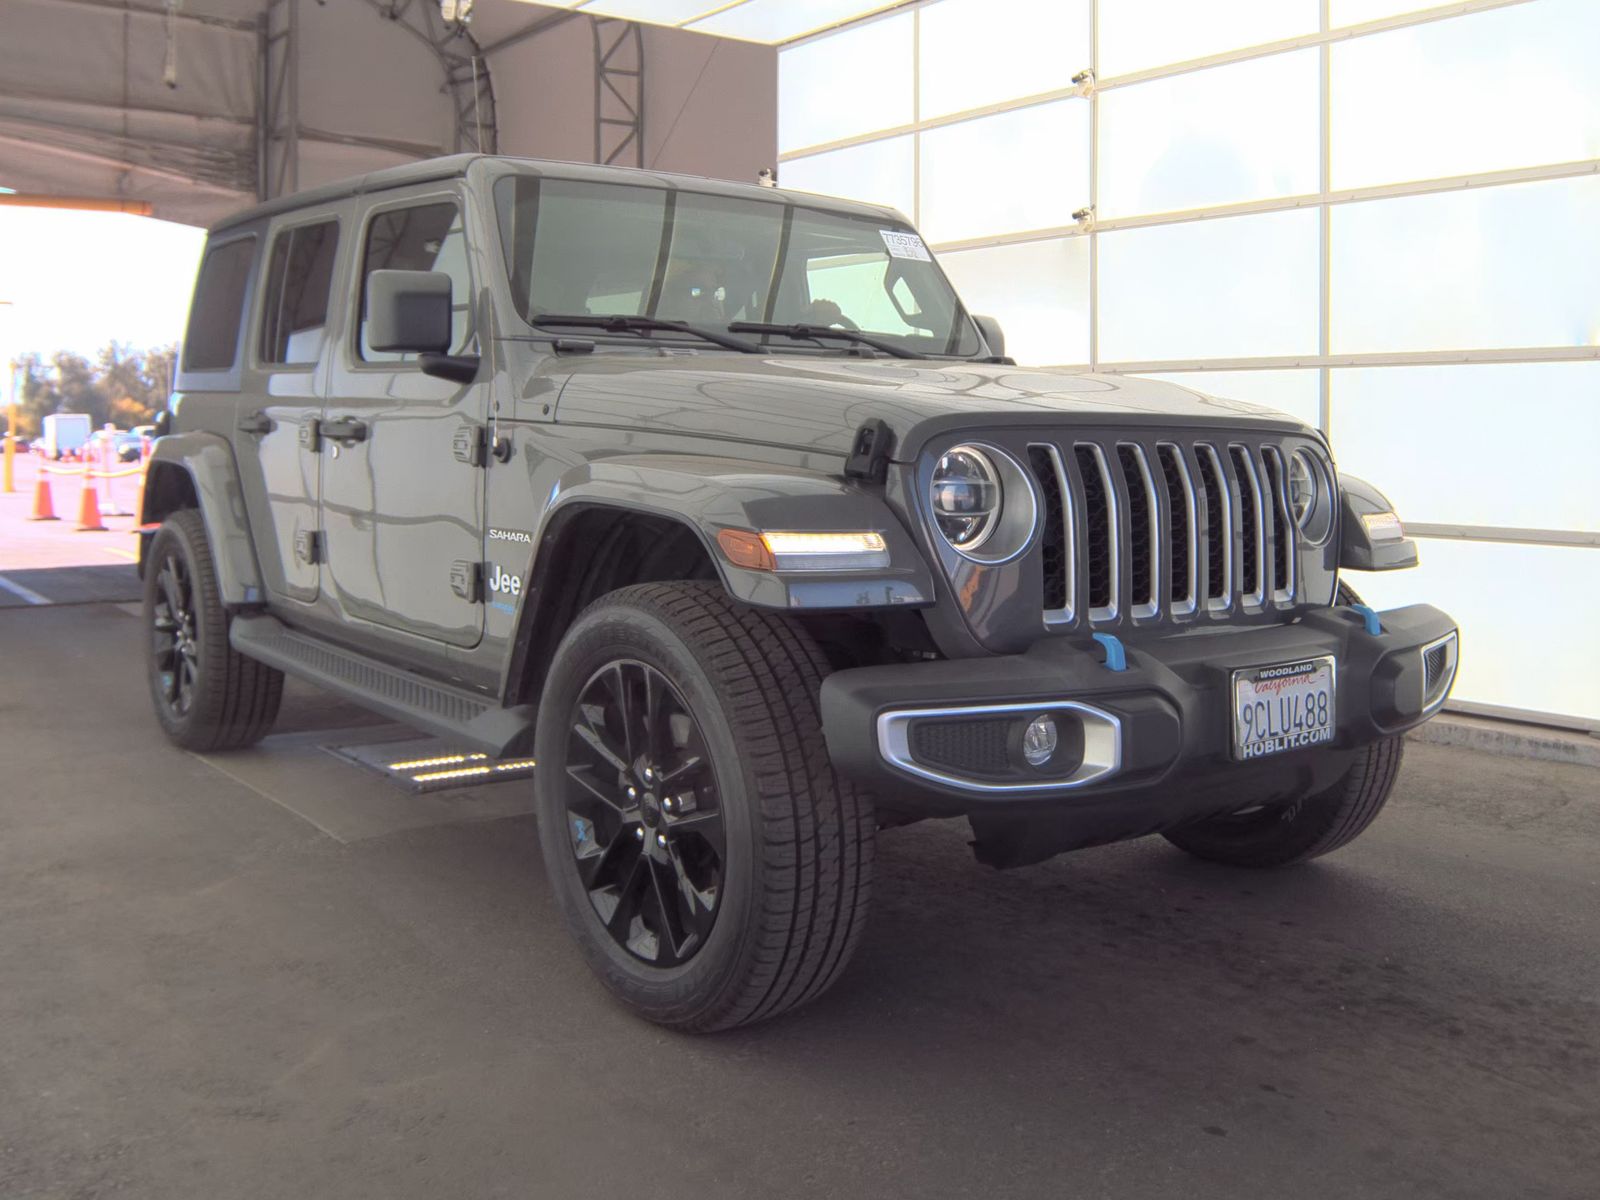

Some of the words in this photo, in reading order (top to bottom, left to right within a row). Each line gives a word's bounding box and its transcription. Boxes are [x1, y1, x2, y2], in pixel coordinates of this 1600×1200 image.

[489, 528, 531, 543] SAHARA
[489, 565, 521, 596] Jee
[1260, 663, 1313, 679] WOODLAND
[1254, 674, 1317, 696] California
[1243, 690, 1328, 744] 9CLU488
[1243, 727, 1331, 759] HOBLIT.COM
